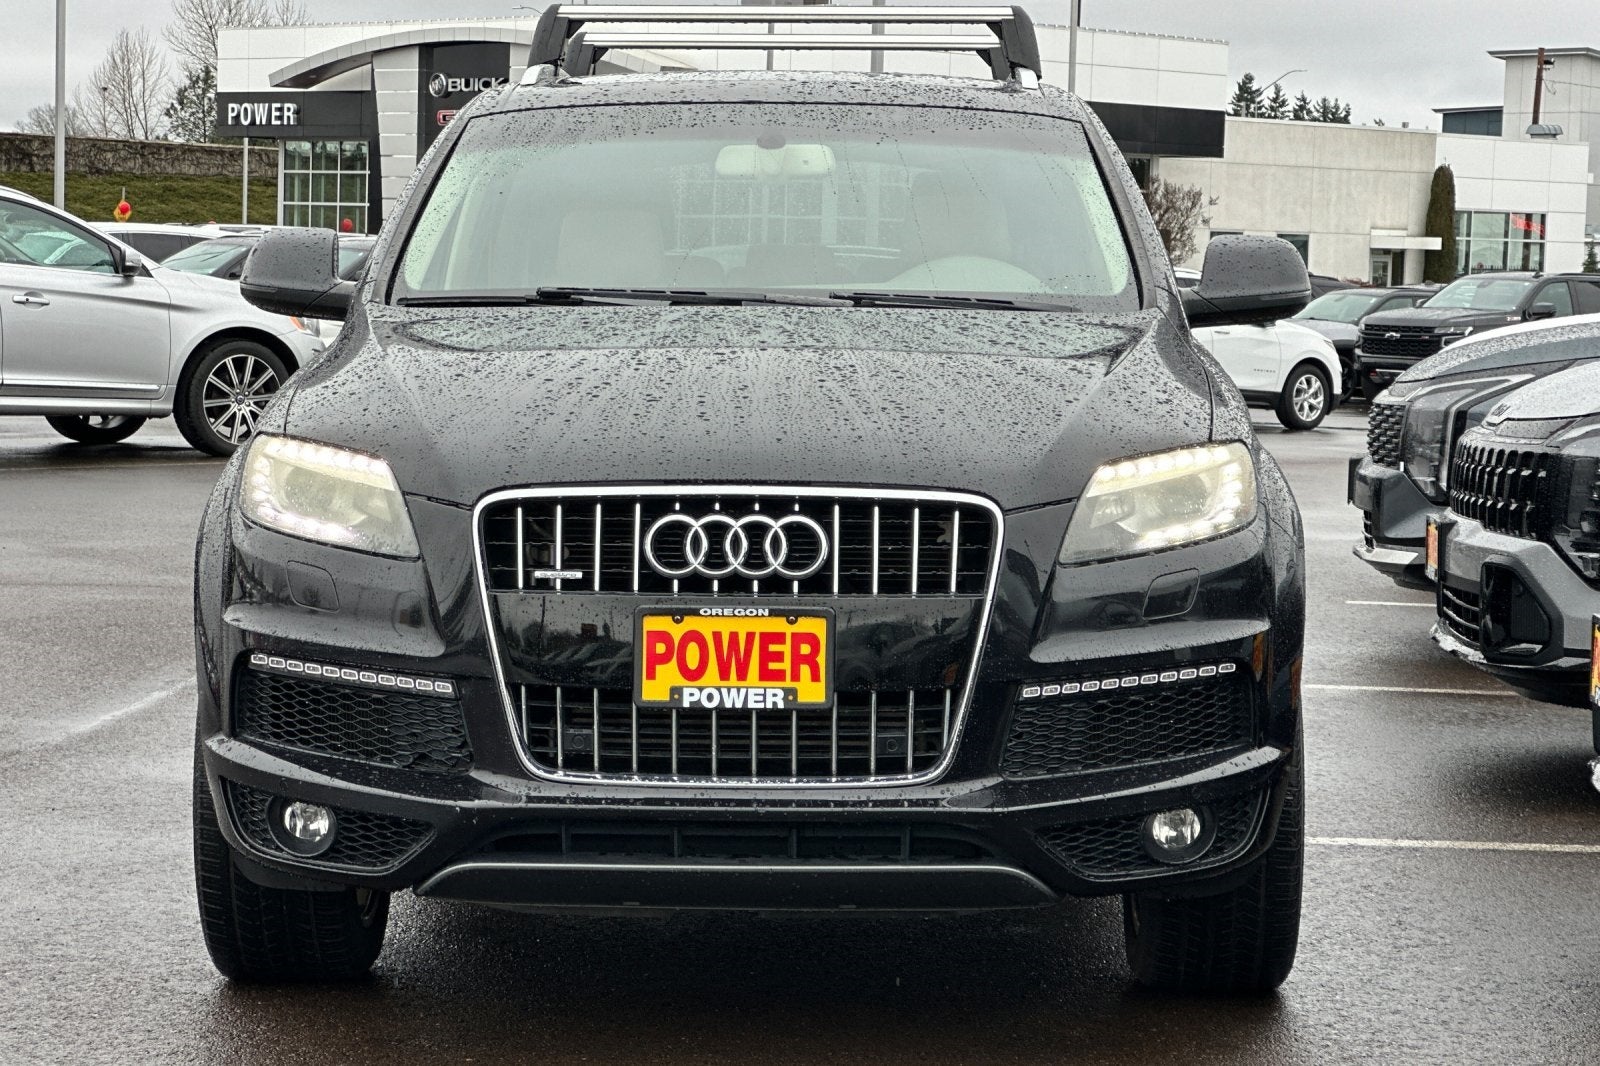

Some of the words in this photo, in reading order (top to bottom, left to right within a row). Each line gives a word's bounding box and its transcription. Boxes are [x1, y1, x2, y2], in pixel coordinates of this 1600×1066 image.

[447, 77, 504, 92] BUICK
[227, 102, 298, 126] POWER
[699, 608, 769, 616] OREGON
[645, 629, 822, 683] POWER
[682, 687, 785, 709] POWER
